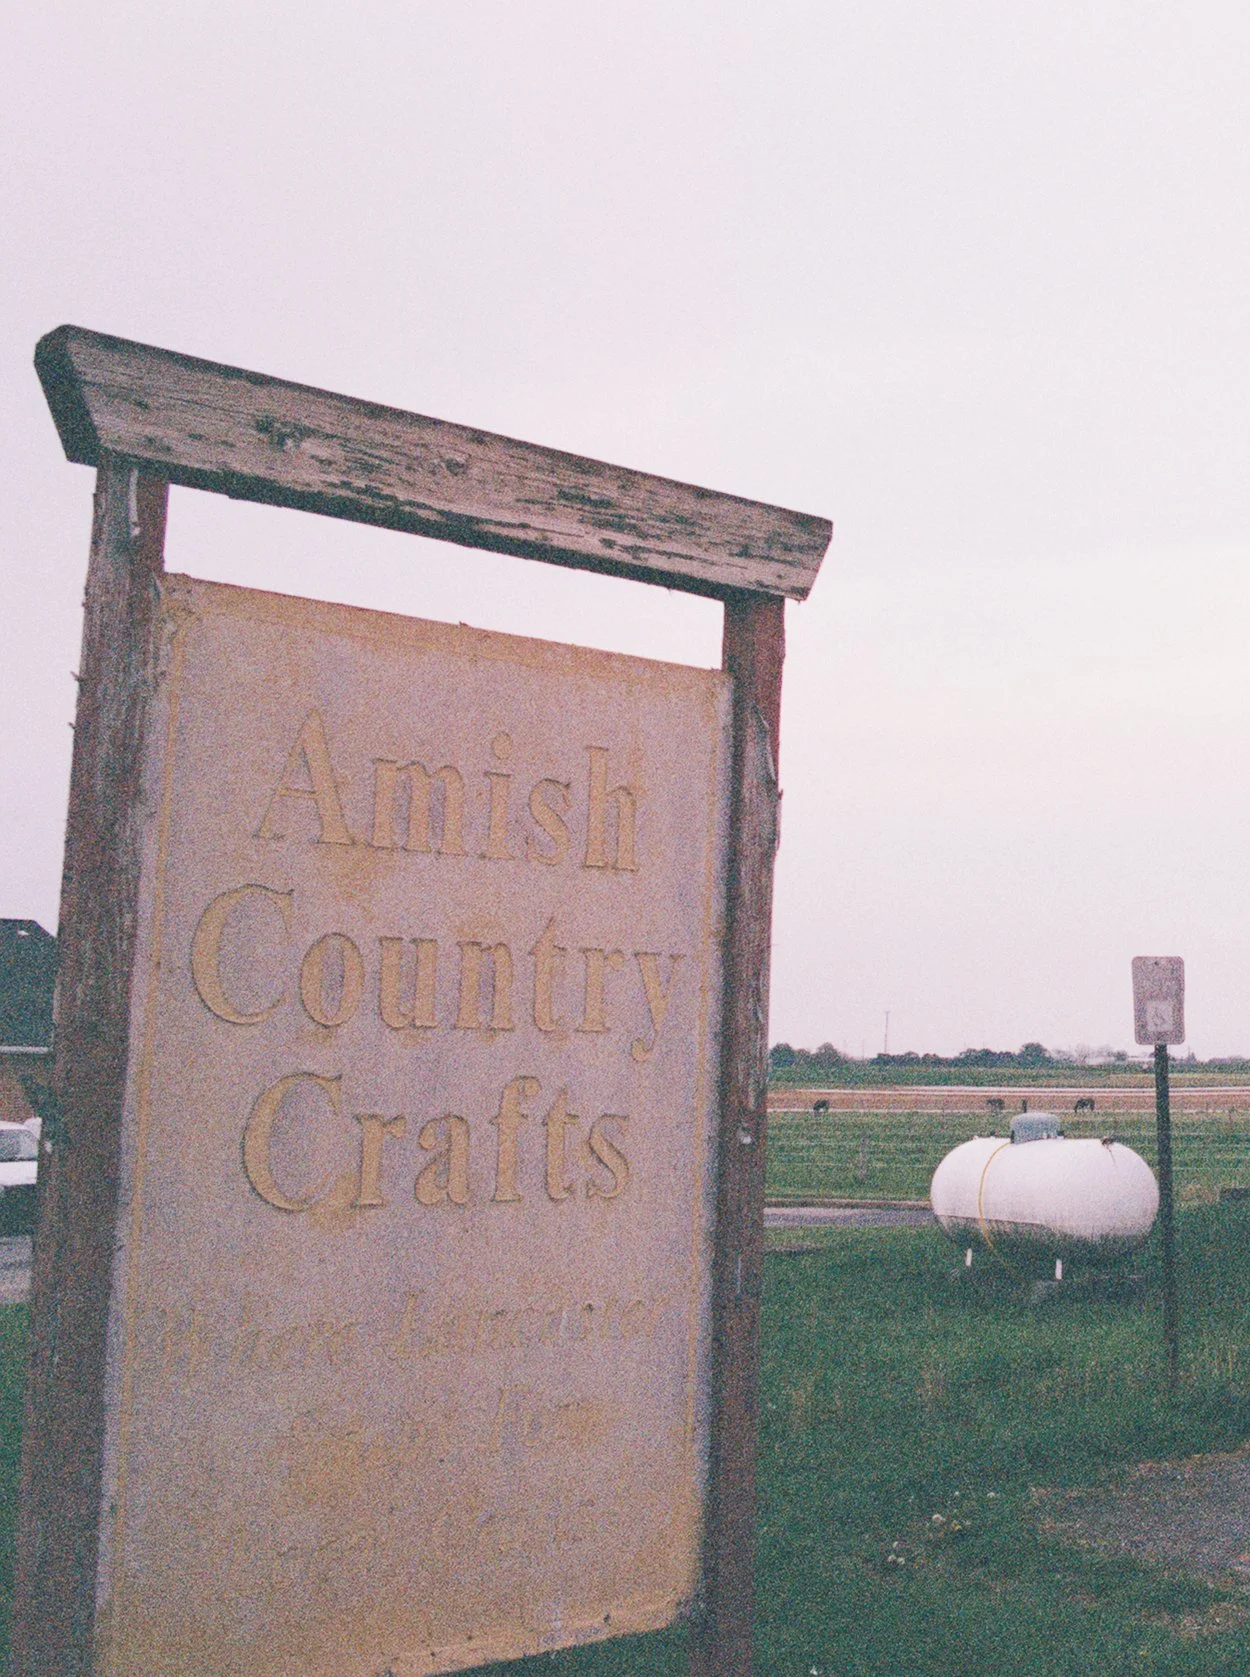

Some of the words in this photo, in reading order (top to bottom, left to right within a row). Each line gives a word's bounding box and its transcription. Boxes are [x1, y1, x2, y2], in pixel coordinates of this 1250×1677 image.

[251, 707, 641, 873] Amish
[190, 882, 687, 1064] Country
[241, 1070, 632, 1213] Crafts
